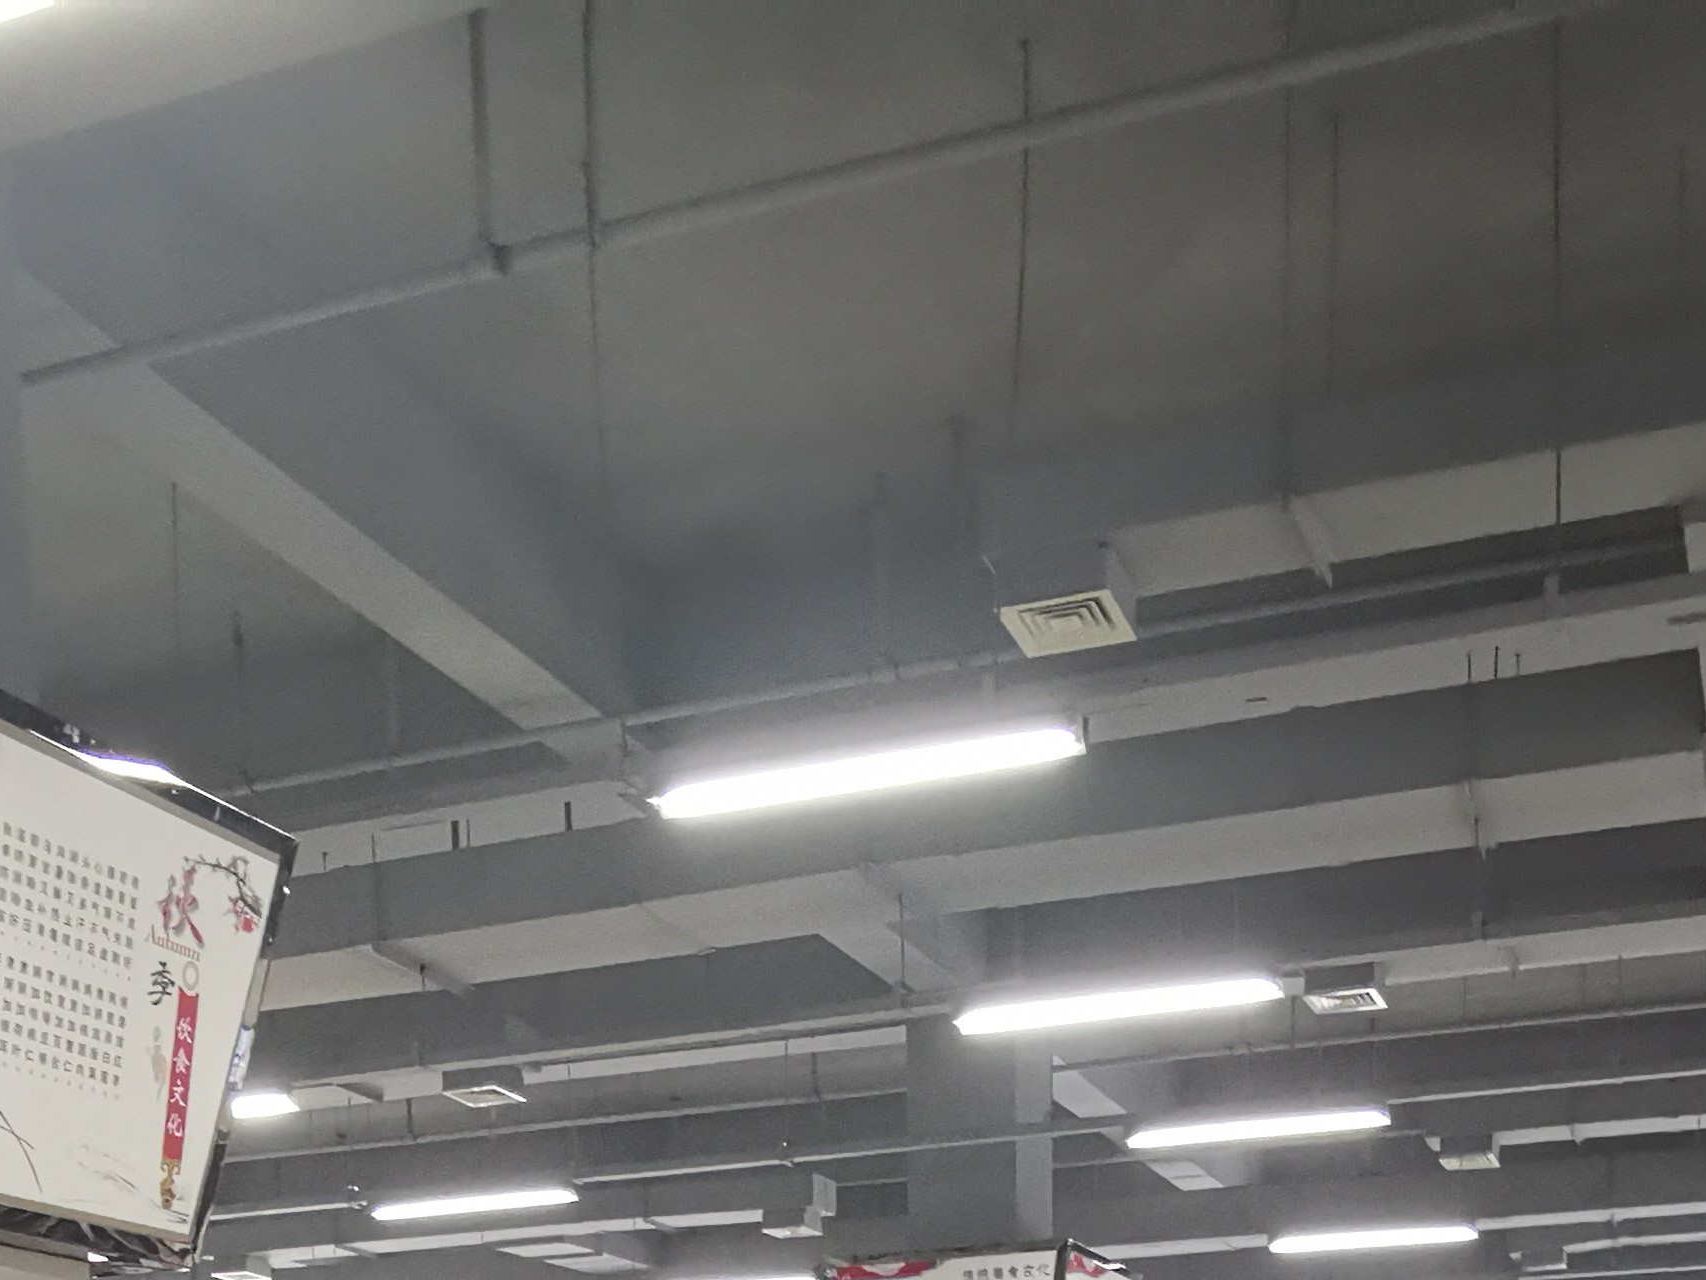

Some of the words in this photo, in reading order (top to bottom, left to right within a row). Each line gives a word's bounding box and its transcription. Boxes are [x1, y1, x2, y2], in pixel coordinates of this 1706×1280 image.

[147, 925, 201, 963] Autumn
[148, 961, 176, 1006] 季
[167, 1016, 194, 1138] 饮食文化
